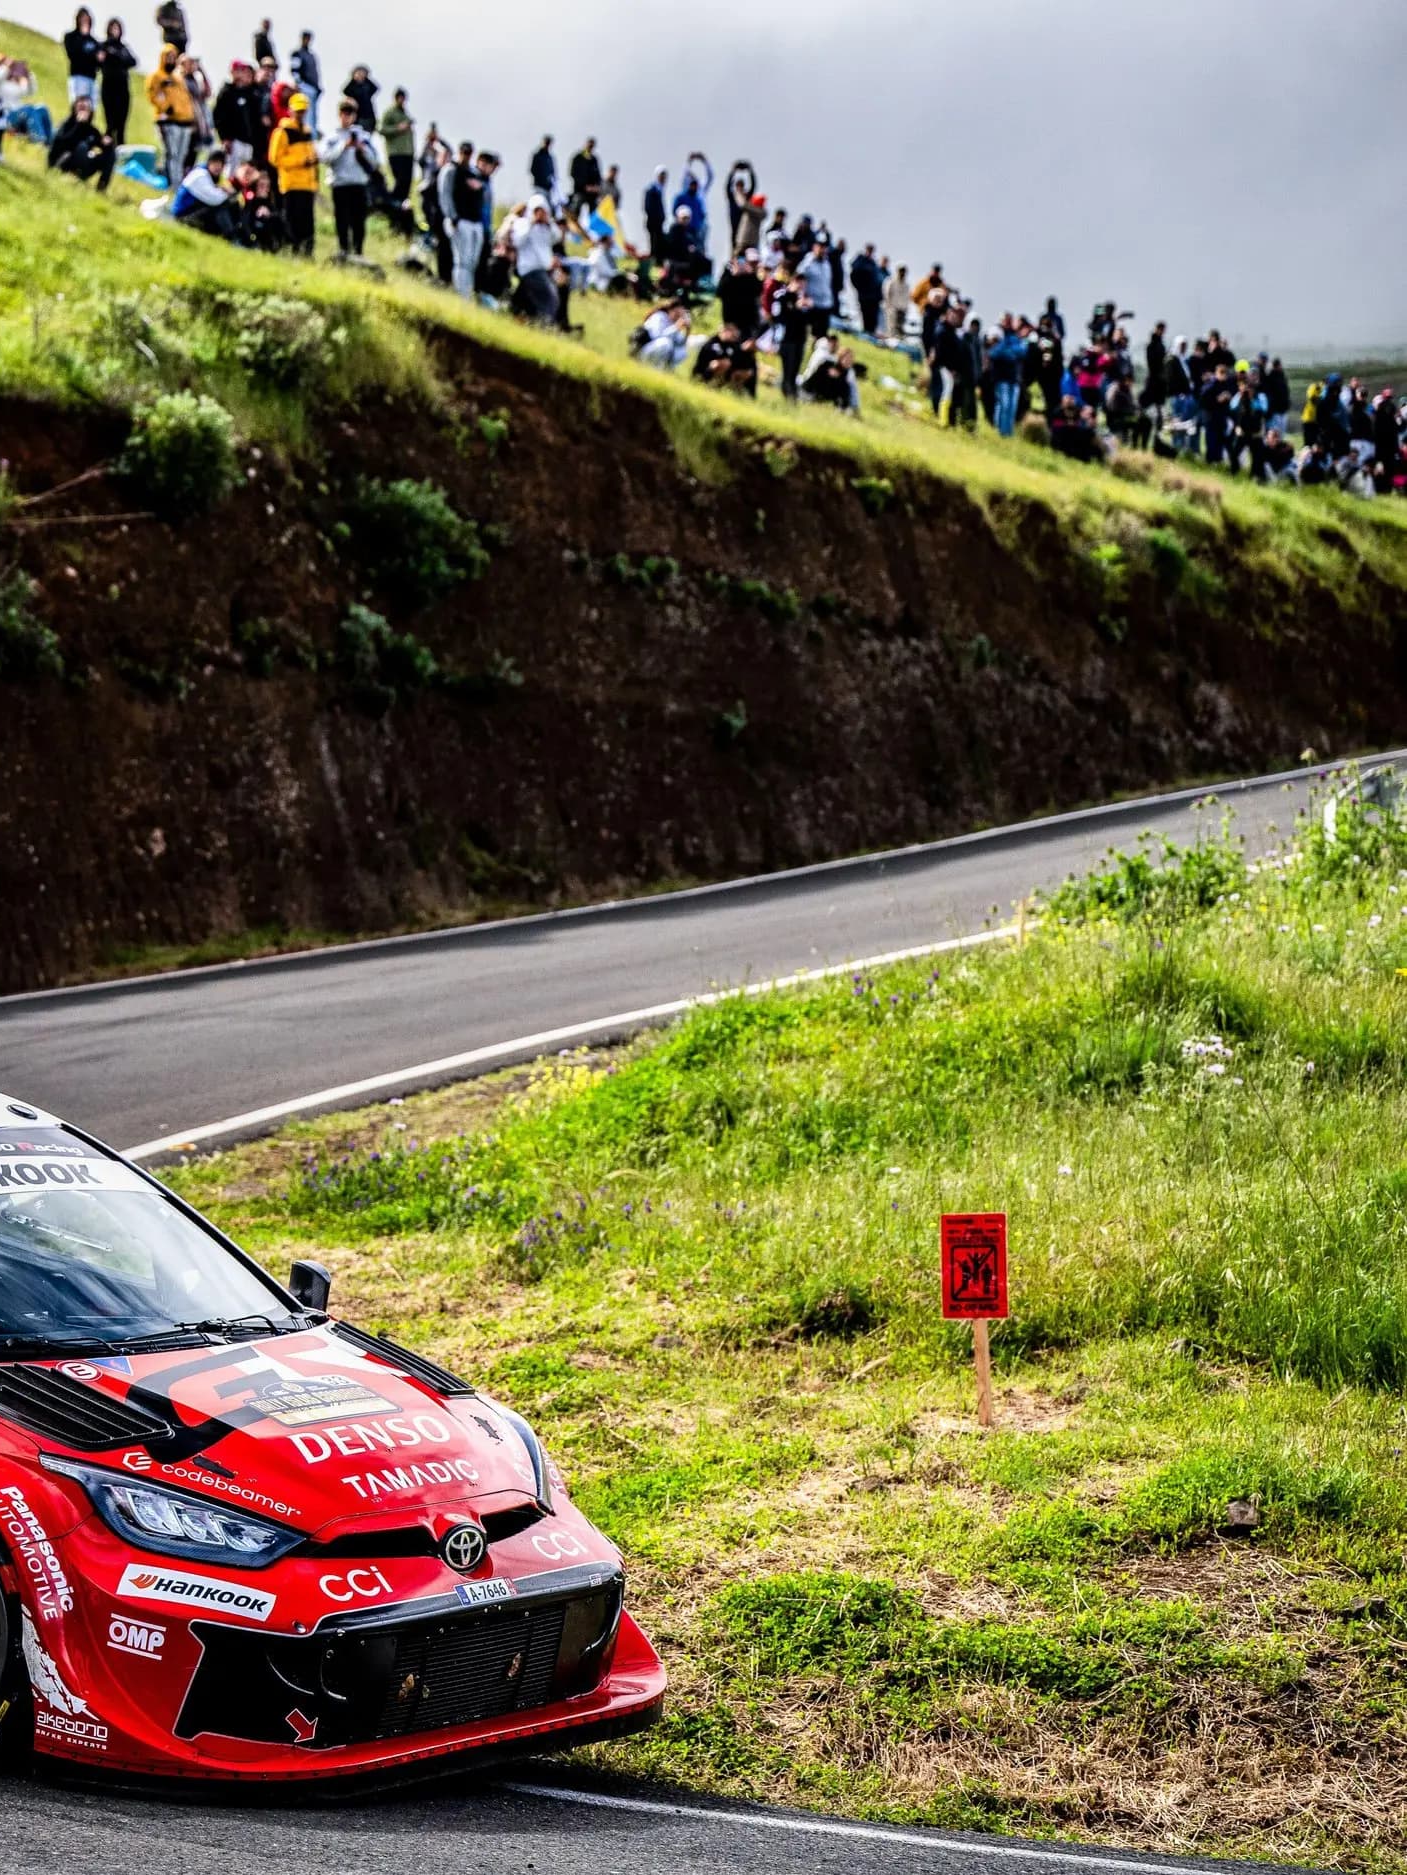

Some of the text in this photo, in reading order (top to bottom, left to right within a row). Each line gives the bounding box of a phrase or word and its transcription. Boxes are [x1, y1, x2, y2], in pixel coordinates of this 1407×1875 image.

[17, 1142, 84, 1157] Racing
[287, 1415, 452, 1465] DENSO
[161, 1463, 298, 1517] codebeamer
[341, 1459, 481, 1499] TAMADIC
[0, 1485, 74, 1612] Panasonic
[470, 1581, 507, 1601] A-7646
[108, 1620, 165, 1653] OMP
[37, 1711, 108, 1739] akebono
[66, 1737, 107, 1750] EXPERTS
